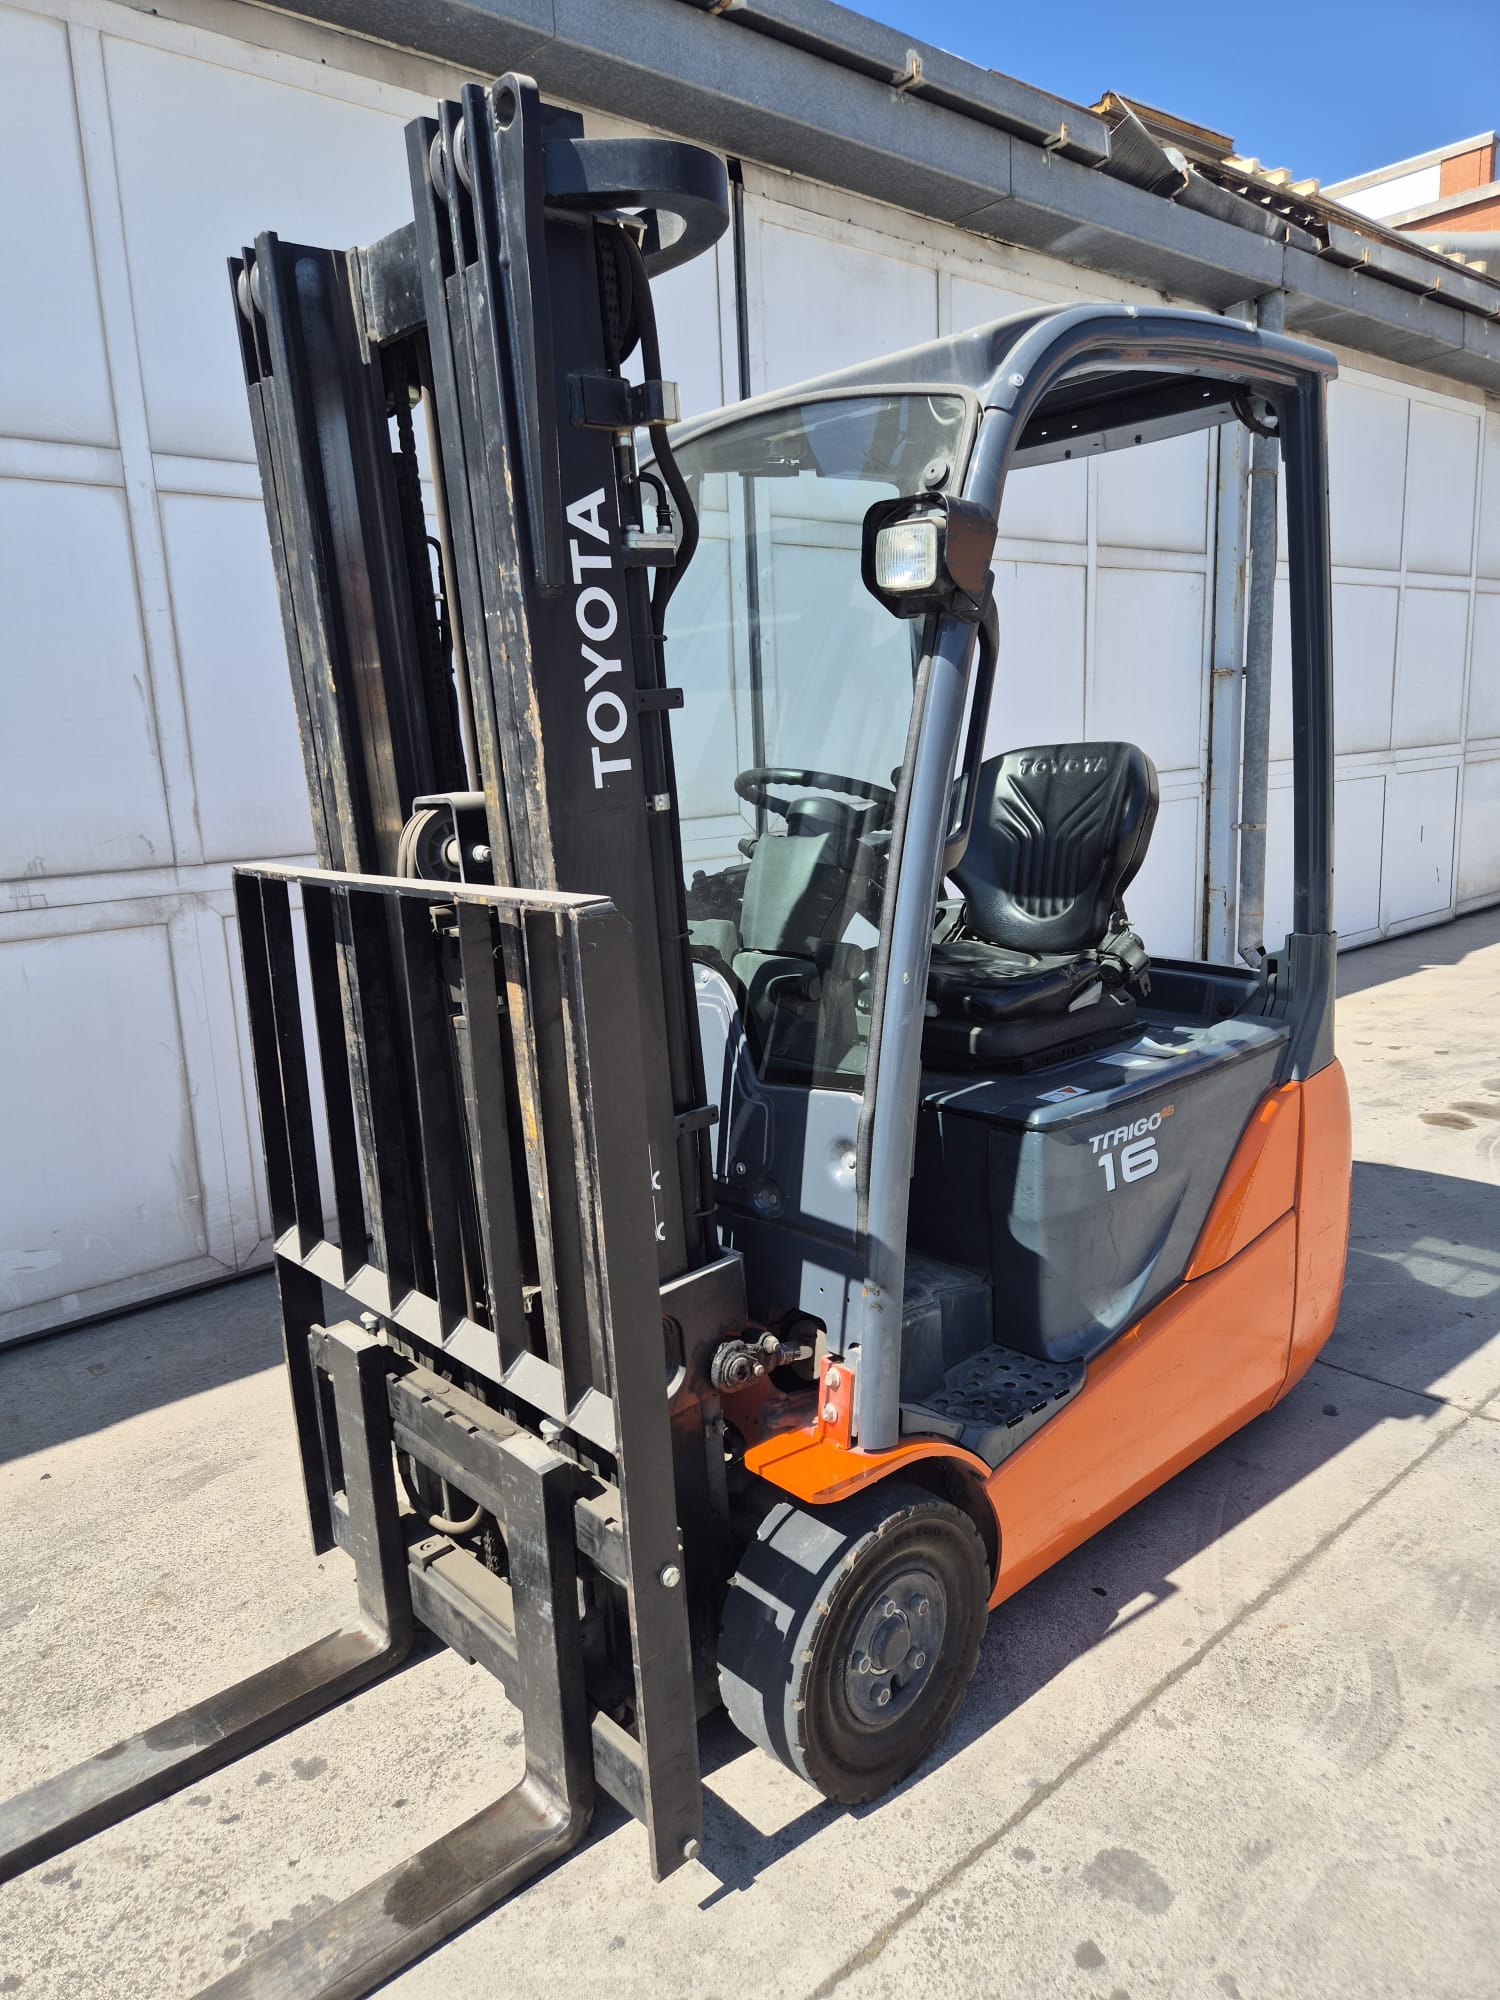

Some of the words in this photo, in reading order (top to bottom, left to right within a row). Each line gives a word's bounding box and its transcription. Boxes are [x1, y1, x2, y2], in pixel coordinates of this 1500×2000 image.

[566, 488, 632, 789] TOYOTA
[1019, 757, 1108, 776] TOYOTA
[1098, 1136, 1159, 1192] 16
